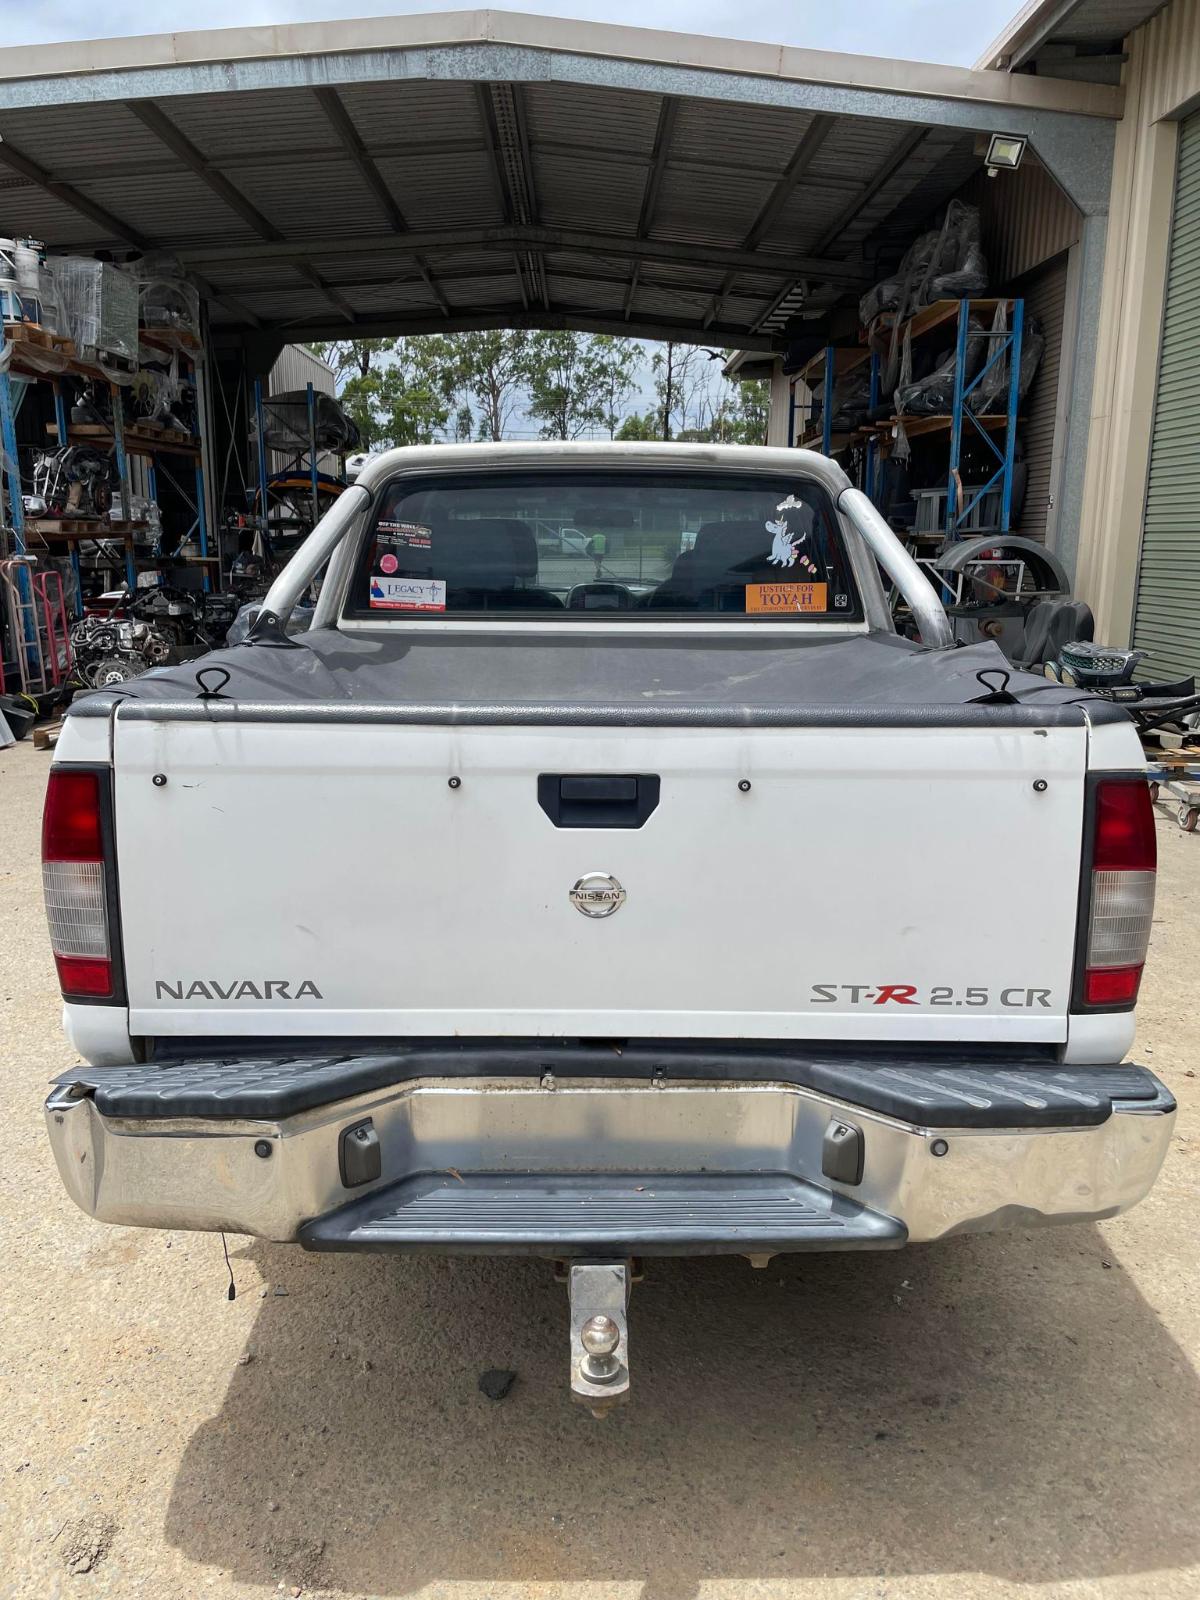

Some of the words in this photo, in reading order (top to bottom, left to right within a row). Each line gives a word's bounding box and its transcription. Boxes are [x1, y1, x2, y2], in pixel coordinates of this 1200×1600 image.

[760, 584, 795, 593] JUSTICE
[796, 584, 815, 592] FOR
[760, 592, 813, 606] TOYAH
[575, 892, 620, 901] NISSAN
[155, 980, 324, 1000] NAVARA
[810, 984, 921, 1005] ST-R
[930, 986, 989, 1006] 2.5
[1000, 988, 1052, 1007] CR
